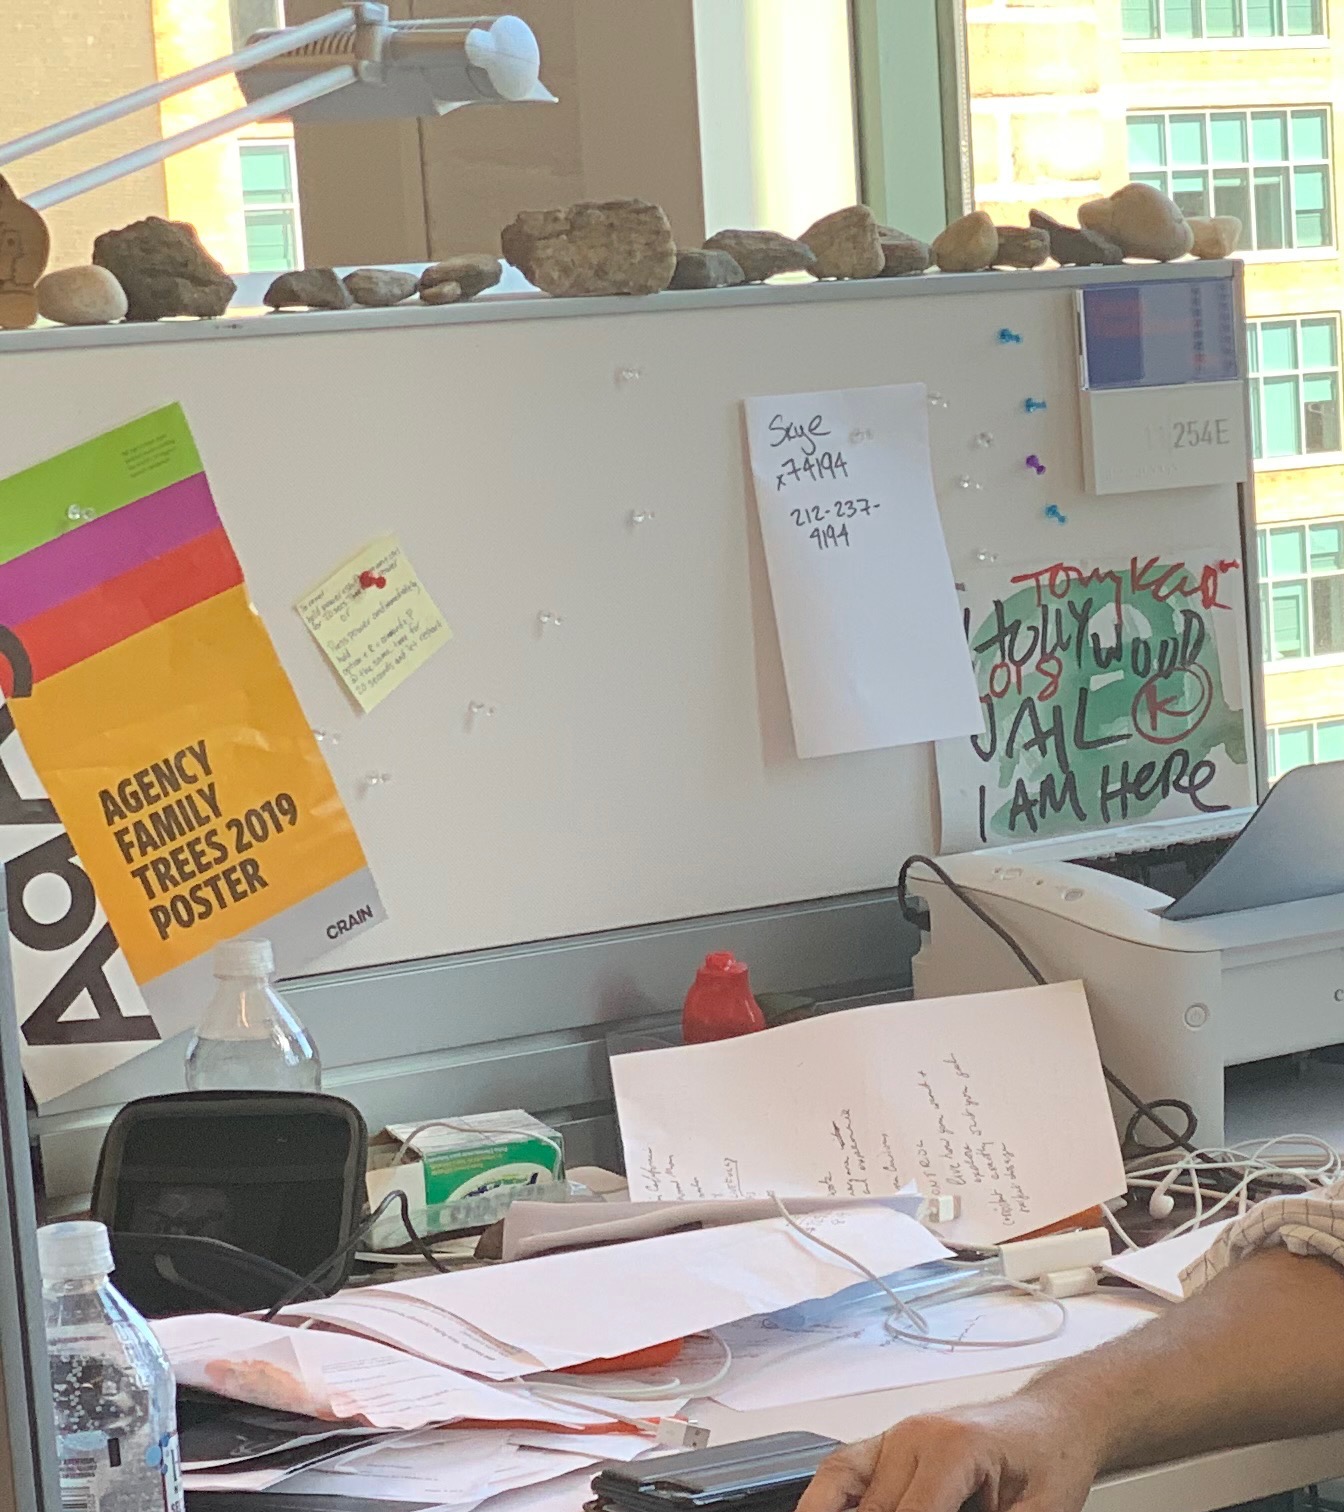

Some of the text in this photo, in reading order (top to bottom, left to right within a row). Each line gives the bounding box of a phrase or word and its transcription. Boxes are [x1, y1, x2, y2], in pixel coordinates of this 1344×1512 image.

[970, 686, 1133, 773] JAIL
[98, 739, 213, 826] AGENCY
[114, 783, 224, 864] FAMILY
[1008, 770, 1087, 833] AM
[131, 792, 299, 900] TREES 2019
[149, 858, 269, 941] POSTER
[326, 904, 374, 940] CRAIN
